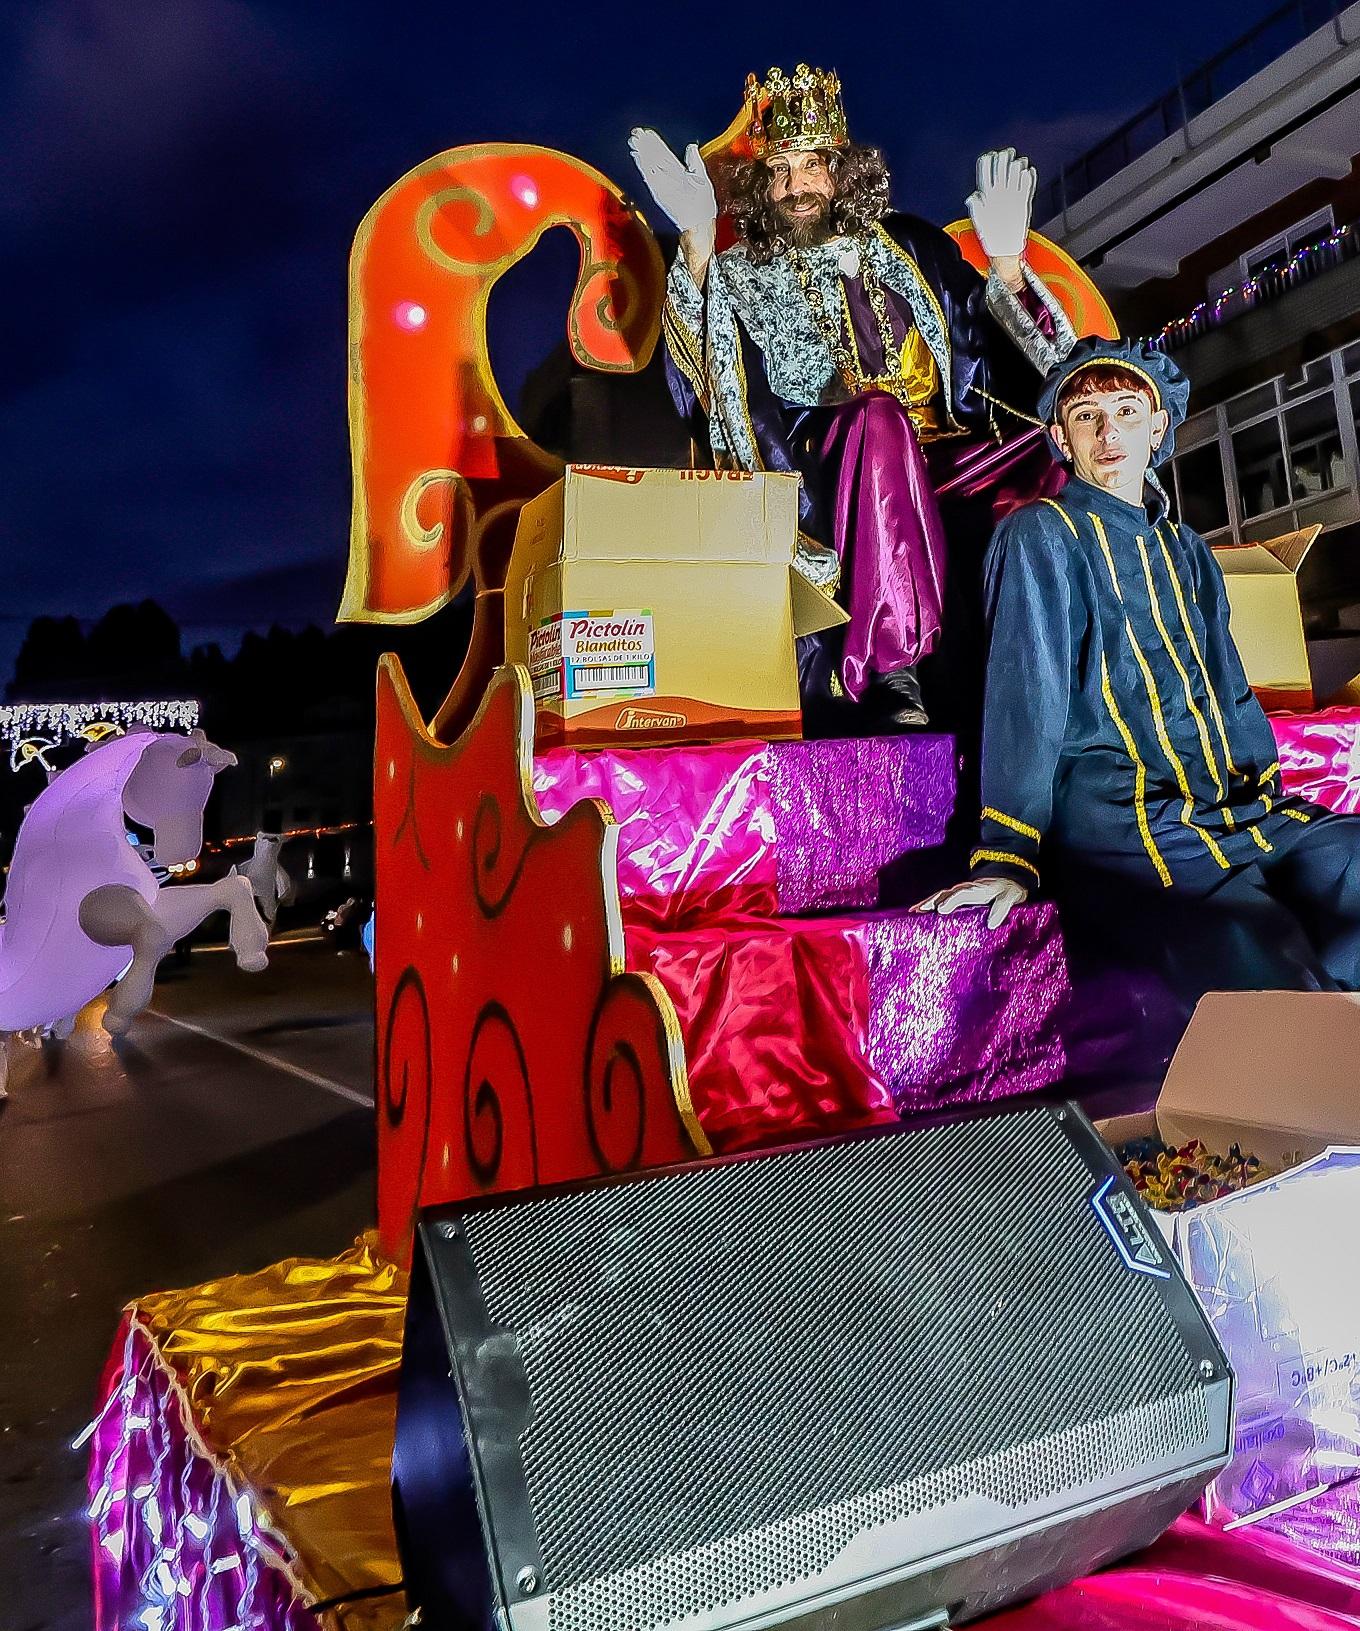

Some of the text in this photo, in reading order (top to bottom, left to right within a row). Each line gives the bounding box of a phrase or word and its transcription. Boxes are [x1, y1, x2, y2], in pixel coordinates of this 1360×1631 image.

[569, 619, 646, 639] Pictolin
[576, 639, 642, 653] Blanditos
[582, 655, 612, 663] BOLSAS
[632, 653, 650, 661] KILO
